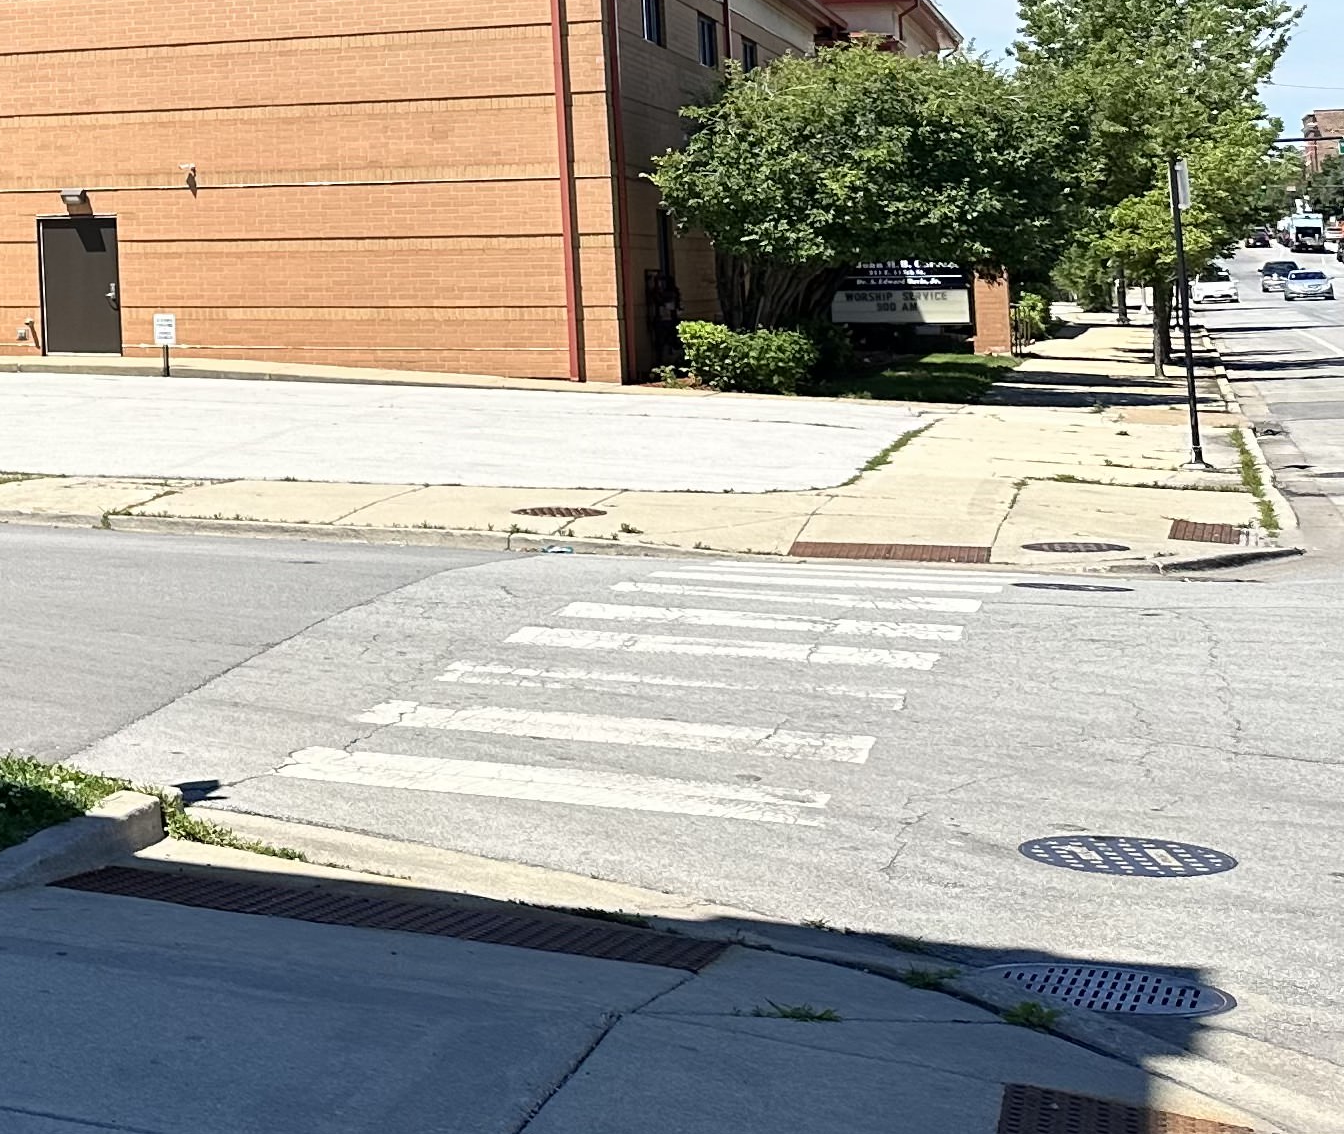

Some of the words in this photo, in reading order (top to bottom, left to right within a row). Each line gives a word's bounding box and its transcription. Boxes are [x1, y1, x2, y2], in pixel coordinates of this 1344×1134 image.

[845, 292, 893, 302] WORSHIP
[902, 291, 948, 301] SERVICE
[902, 302, 918, 312] AM
